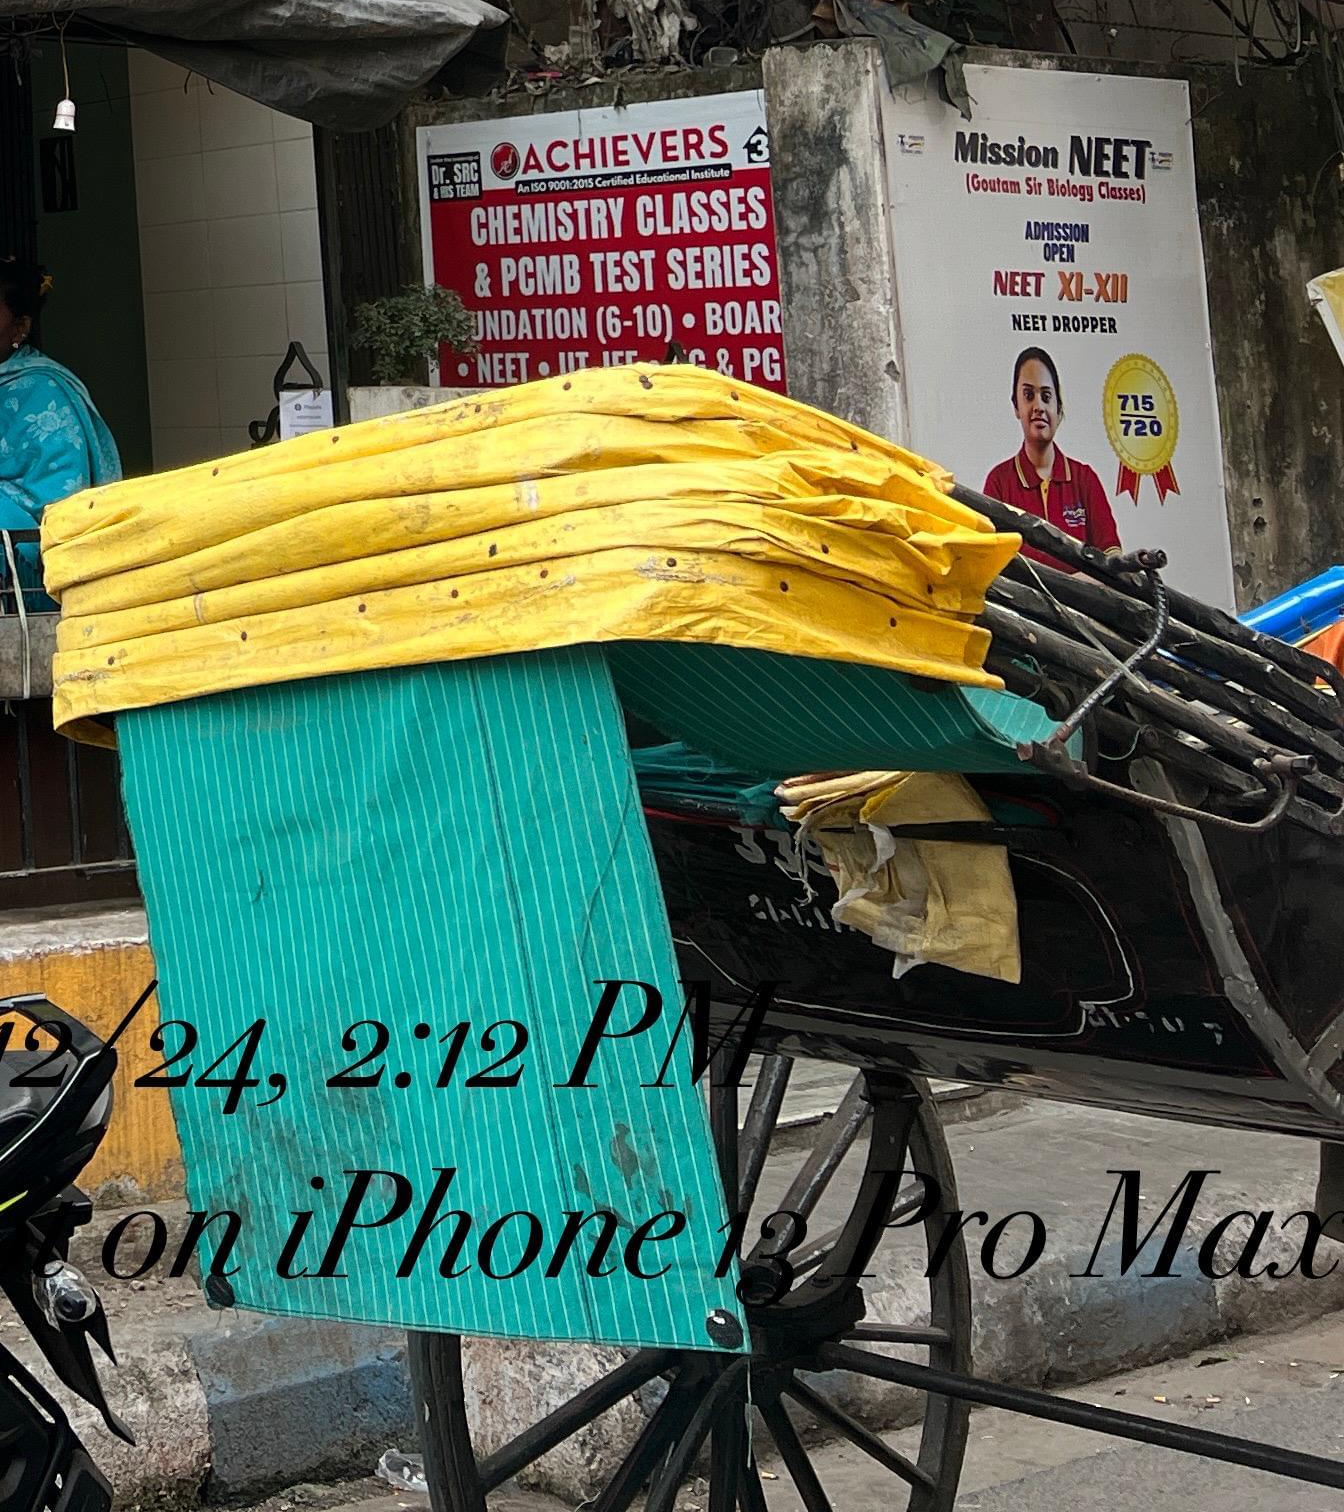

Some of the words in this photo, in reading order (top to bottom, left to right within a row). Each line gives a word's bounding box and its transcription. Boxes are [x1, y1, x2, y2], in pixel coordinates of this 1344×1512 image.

[522, 125, 730, 176] ACHIEVERS
[954, 131, 1060, 171] Mission
[1069, 135, 1152, 180] NEET
[454, 162, 480, 184] SRC
[516, 184, 530, 194] An
[531, 181, 546, 193] ISO
[548, 177, 594, 192] 9001:2015
[596, 173, 634, 188] Certified
[636, 168, 689, 184] Educational
[691, 167, 730, 179] Institute
[965, 172, 1023, 196] (Goutam
[1026, 176, 1044, 196] Sir
[1047, 178, 1096, 203] Biology
[1097, 182, 1147, 206] Classes)
[470, 197, 625, 247] CHEMISTRY
[636, 186, 767, 237] CLASSES
[1024, 220, 1091, 243] ADMISSION
[1042, 242, 1075, 264] OPEN
[474, 262, 493, 299] &
[501, 253, 582, 297] PCMB
[590, 249, 657, 294] TEST
[667, 243, 772, 291] SERIES
[993, 270, 1046, 299] NEET
[1057, 271, 1130, 304] XI-XII
[596, 303, 674, 345] (6-10)
[1011, 313, 1048, 333] NEET
[1052, 315, 1118, 335] DROPPER
[1117, 393, 1156, 413] 715
[1119, 419, 1164, 439] 720
